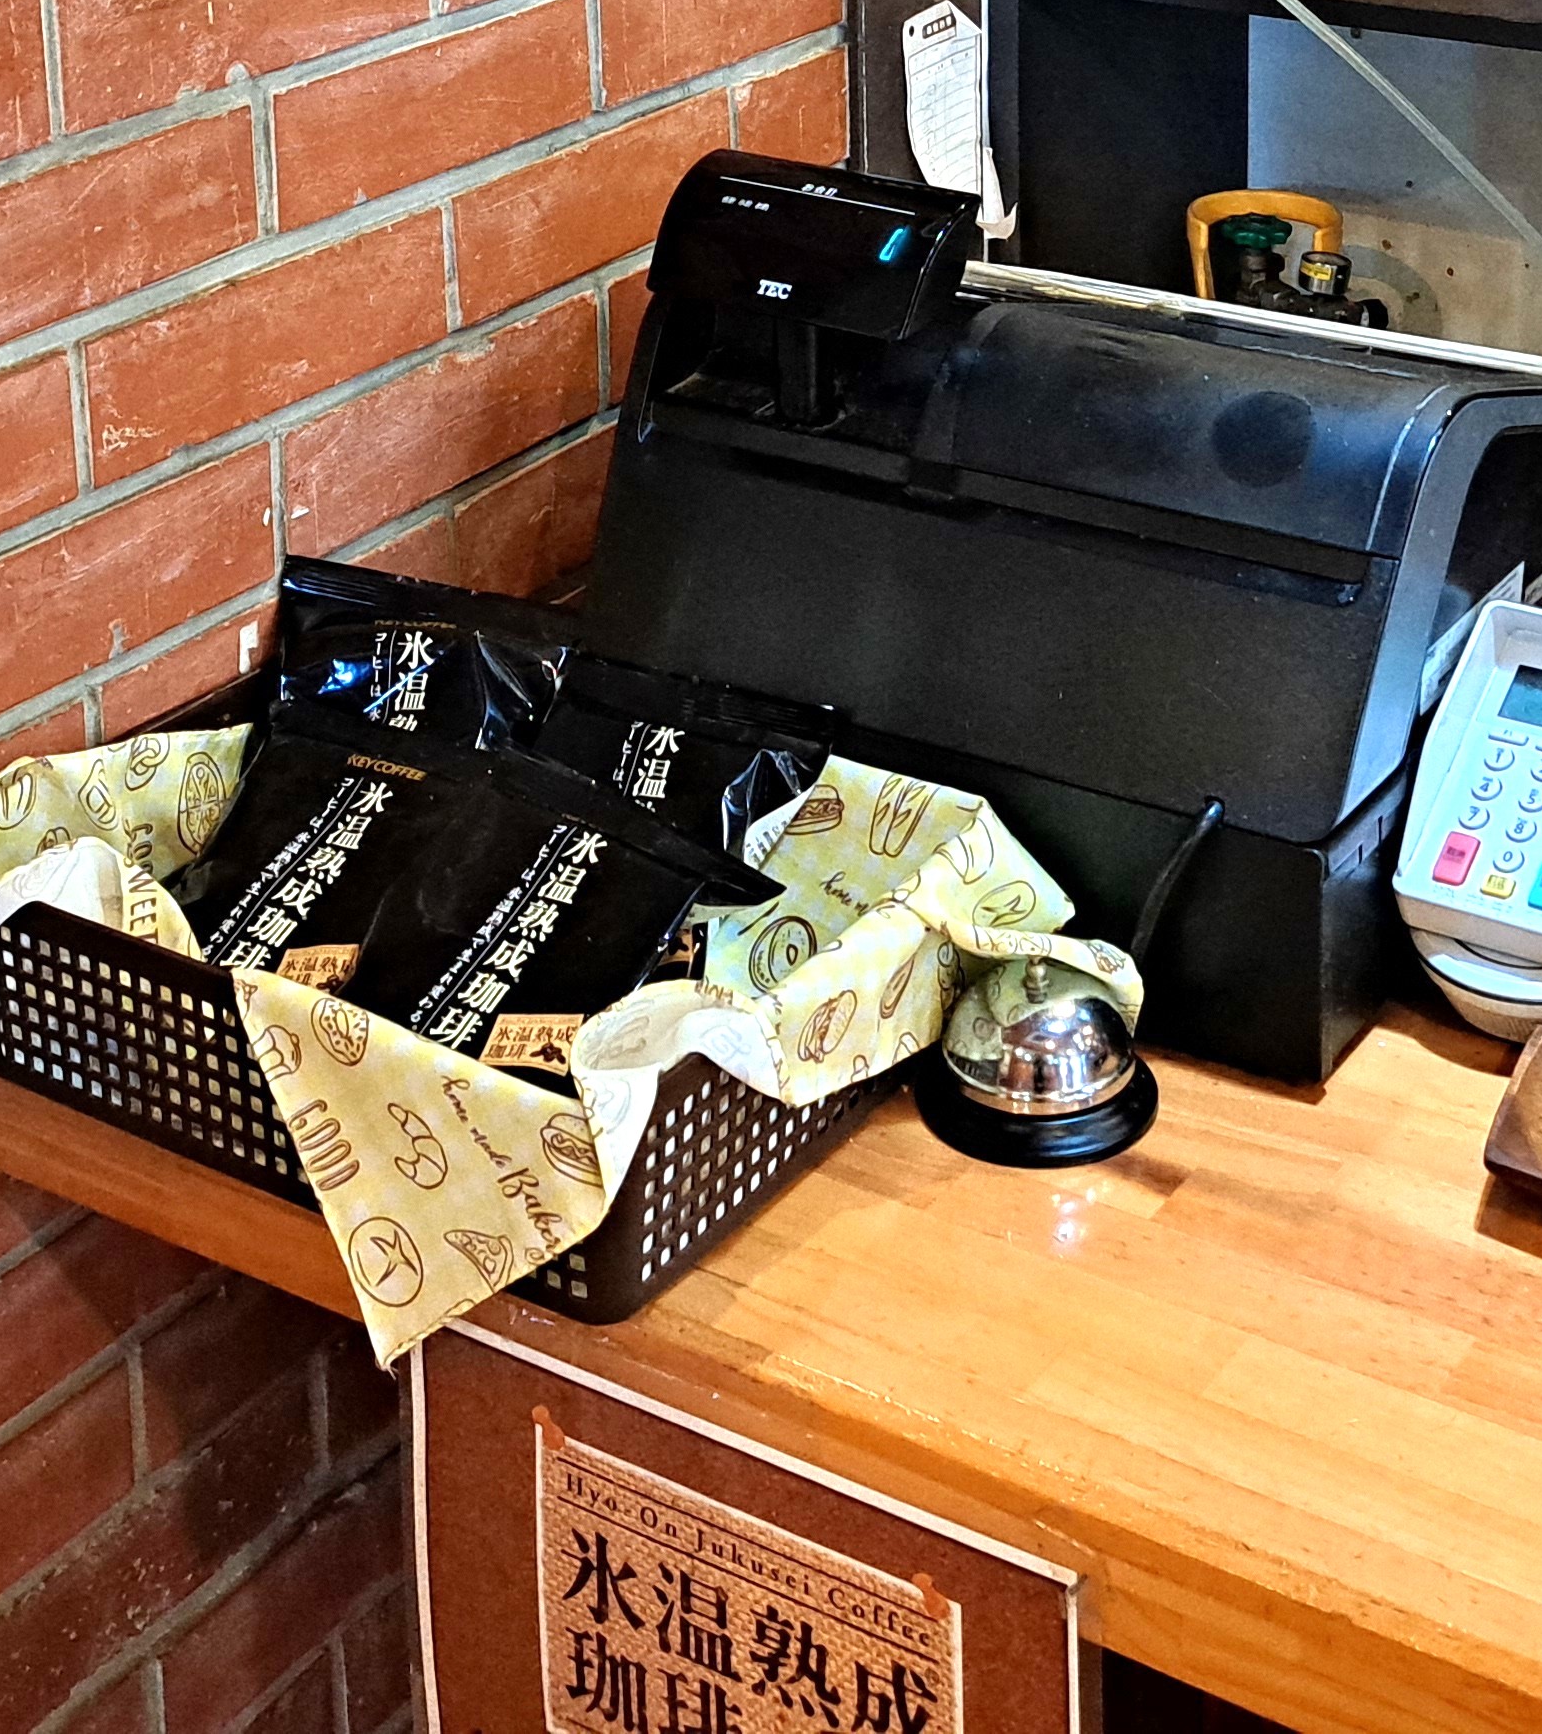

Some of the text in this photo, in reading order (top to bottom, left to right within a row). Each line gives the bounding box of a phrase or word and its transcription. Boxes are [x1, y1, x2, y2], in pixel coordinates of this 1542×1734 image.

[756, 279, 793, 300] TEC
[632, 725, 686, 813] 氷温
[218, 781, 394, 971] 氷温熟成珈琲
[429, 830, 609, 1050] 氷温熟成珈琲
[562, 1526, 939, 1734] 氷温熟成
[565, 1471, 931, 1647] Hyo-On Jukusei Coffee
[565, 1626, 743, 1734] 珈琲
